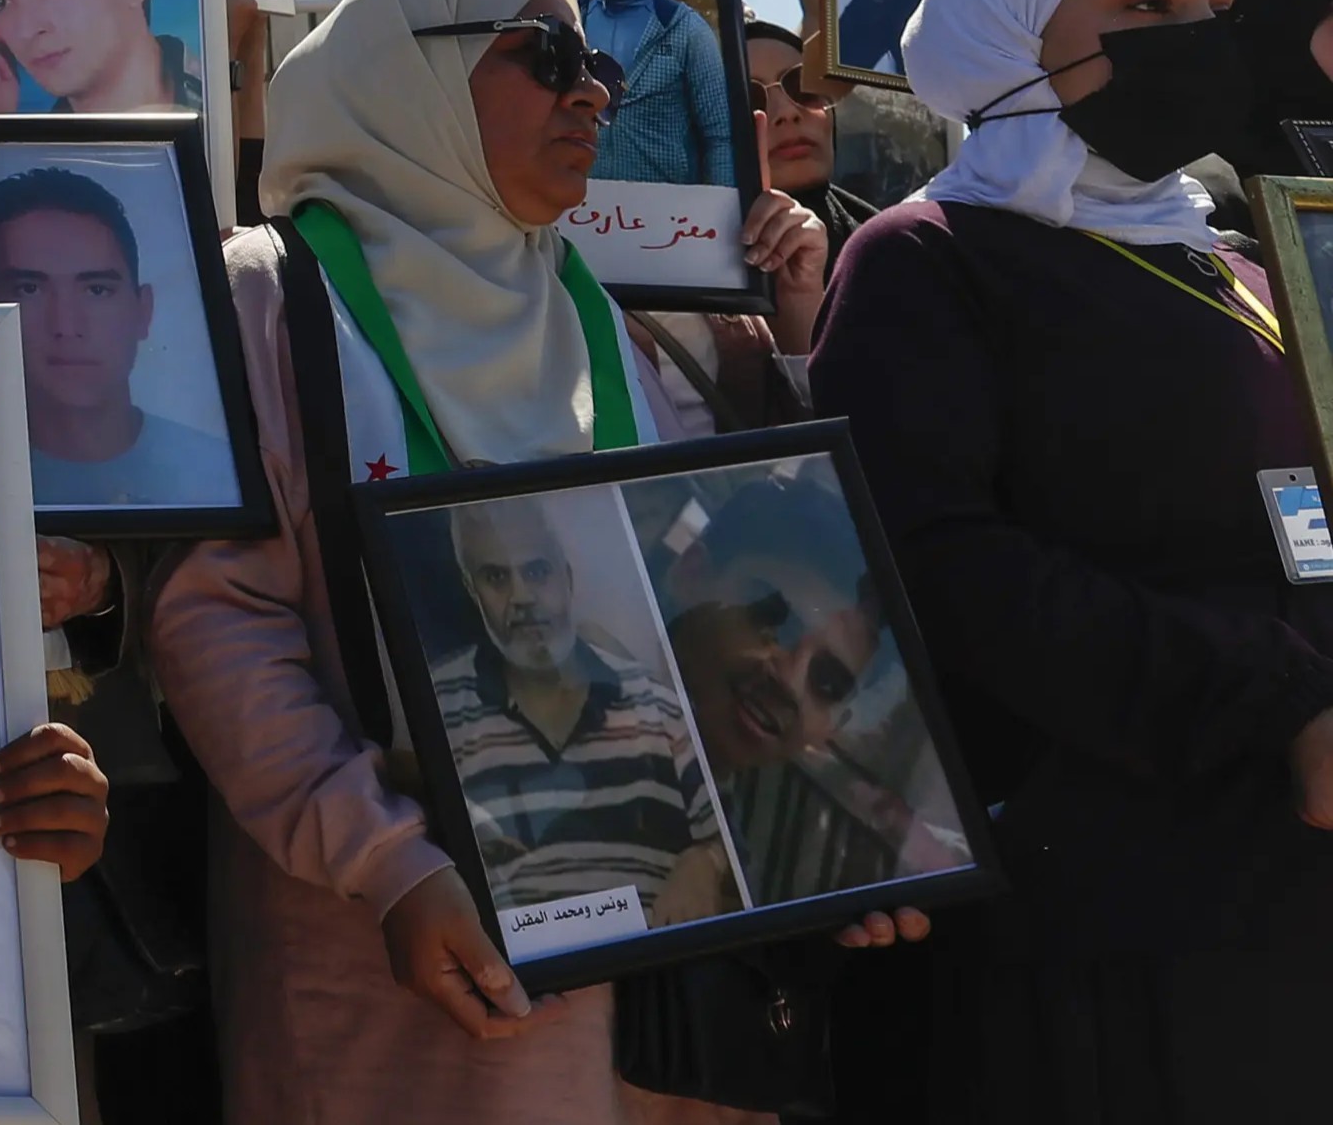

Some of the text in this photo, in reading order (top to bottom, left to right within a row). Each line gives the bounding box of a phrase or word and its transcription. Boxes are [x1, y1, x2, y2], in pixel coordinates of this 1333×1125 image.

[568, 201, 717, 250] معتز عارف
[511, 896, 629, 933] يونس ومحمد المقبل
